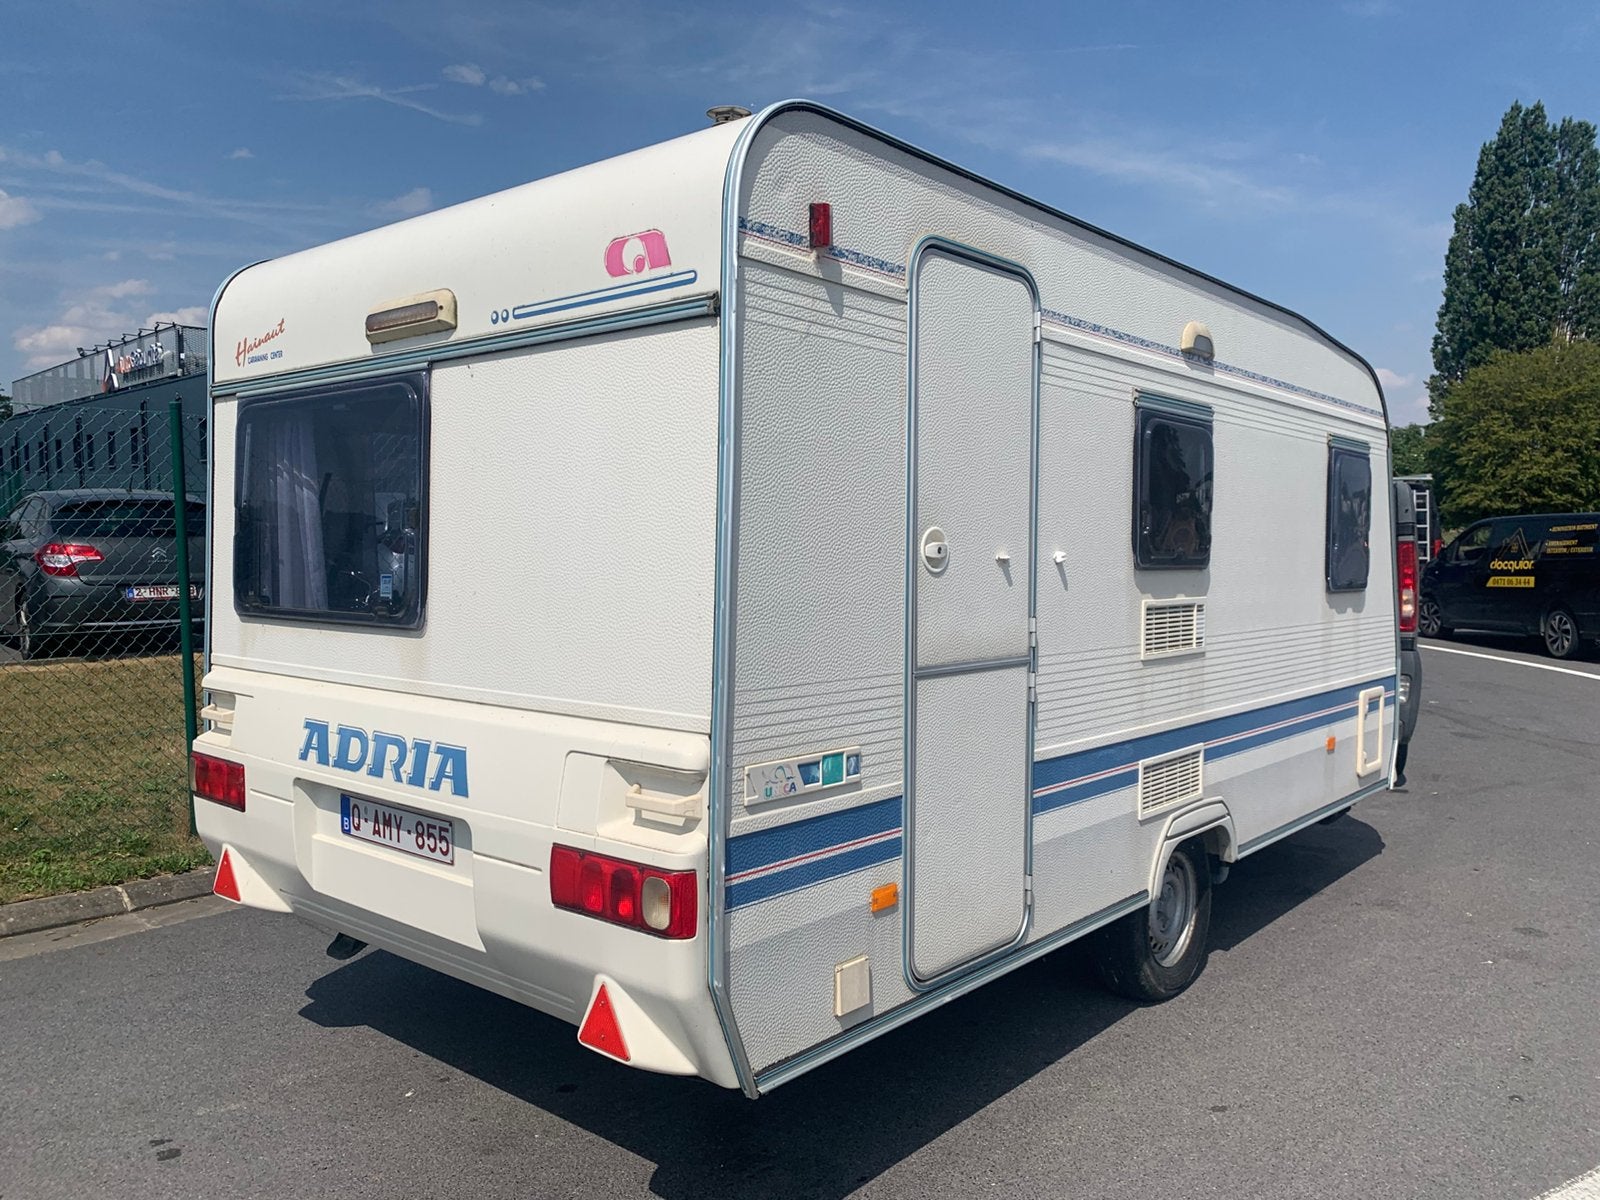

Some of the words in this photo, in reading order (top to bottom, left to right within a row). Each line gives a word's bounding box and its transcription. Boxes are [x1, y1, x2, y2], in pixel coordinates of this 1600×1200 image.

[235, 318, 285, 367] Hainaut
[298, 717, 469, 798] ADRIA
[343, 817, 350, 830] B
